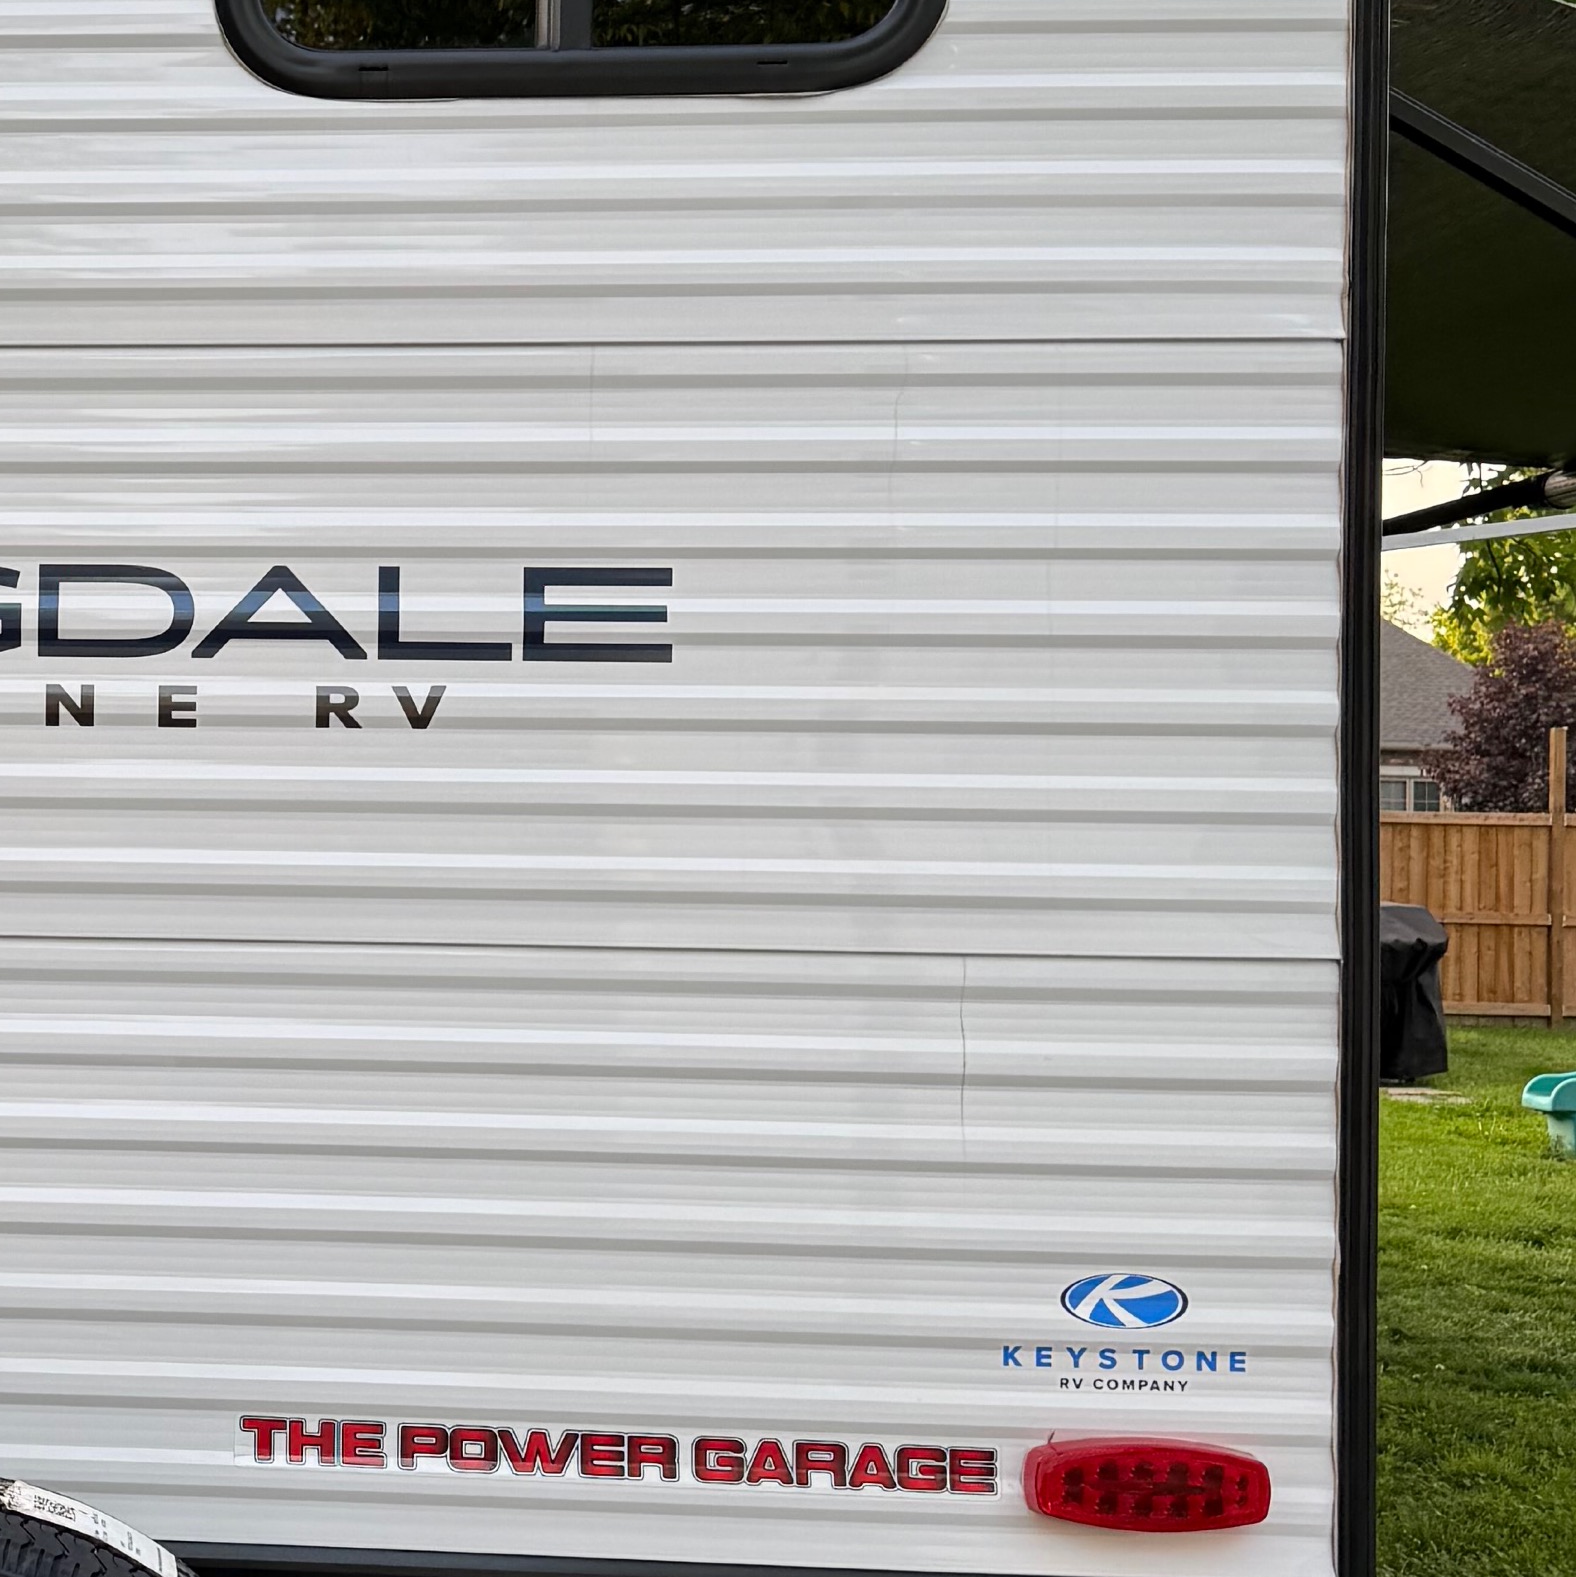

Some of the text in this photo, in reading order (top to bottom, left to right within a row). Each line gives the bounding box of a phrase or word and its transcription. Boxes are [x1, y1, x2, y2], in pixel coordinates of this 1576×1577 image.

[314, 684, 447, 732] RV
[1002, 1345, 1247, 1372] KEYSTONE
[1060, 1377, 1189, 1392] RV COMPANY
[239, 1415, 999, 1496] THE POWER GARAGE
